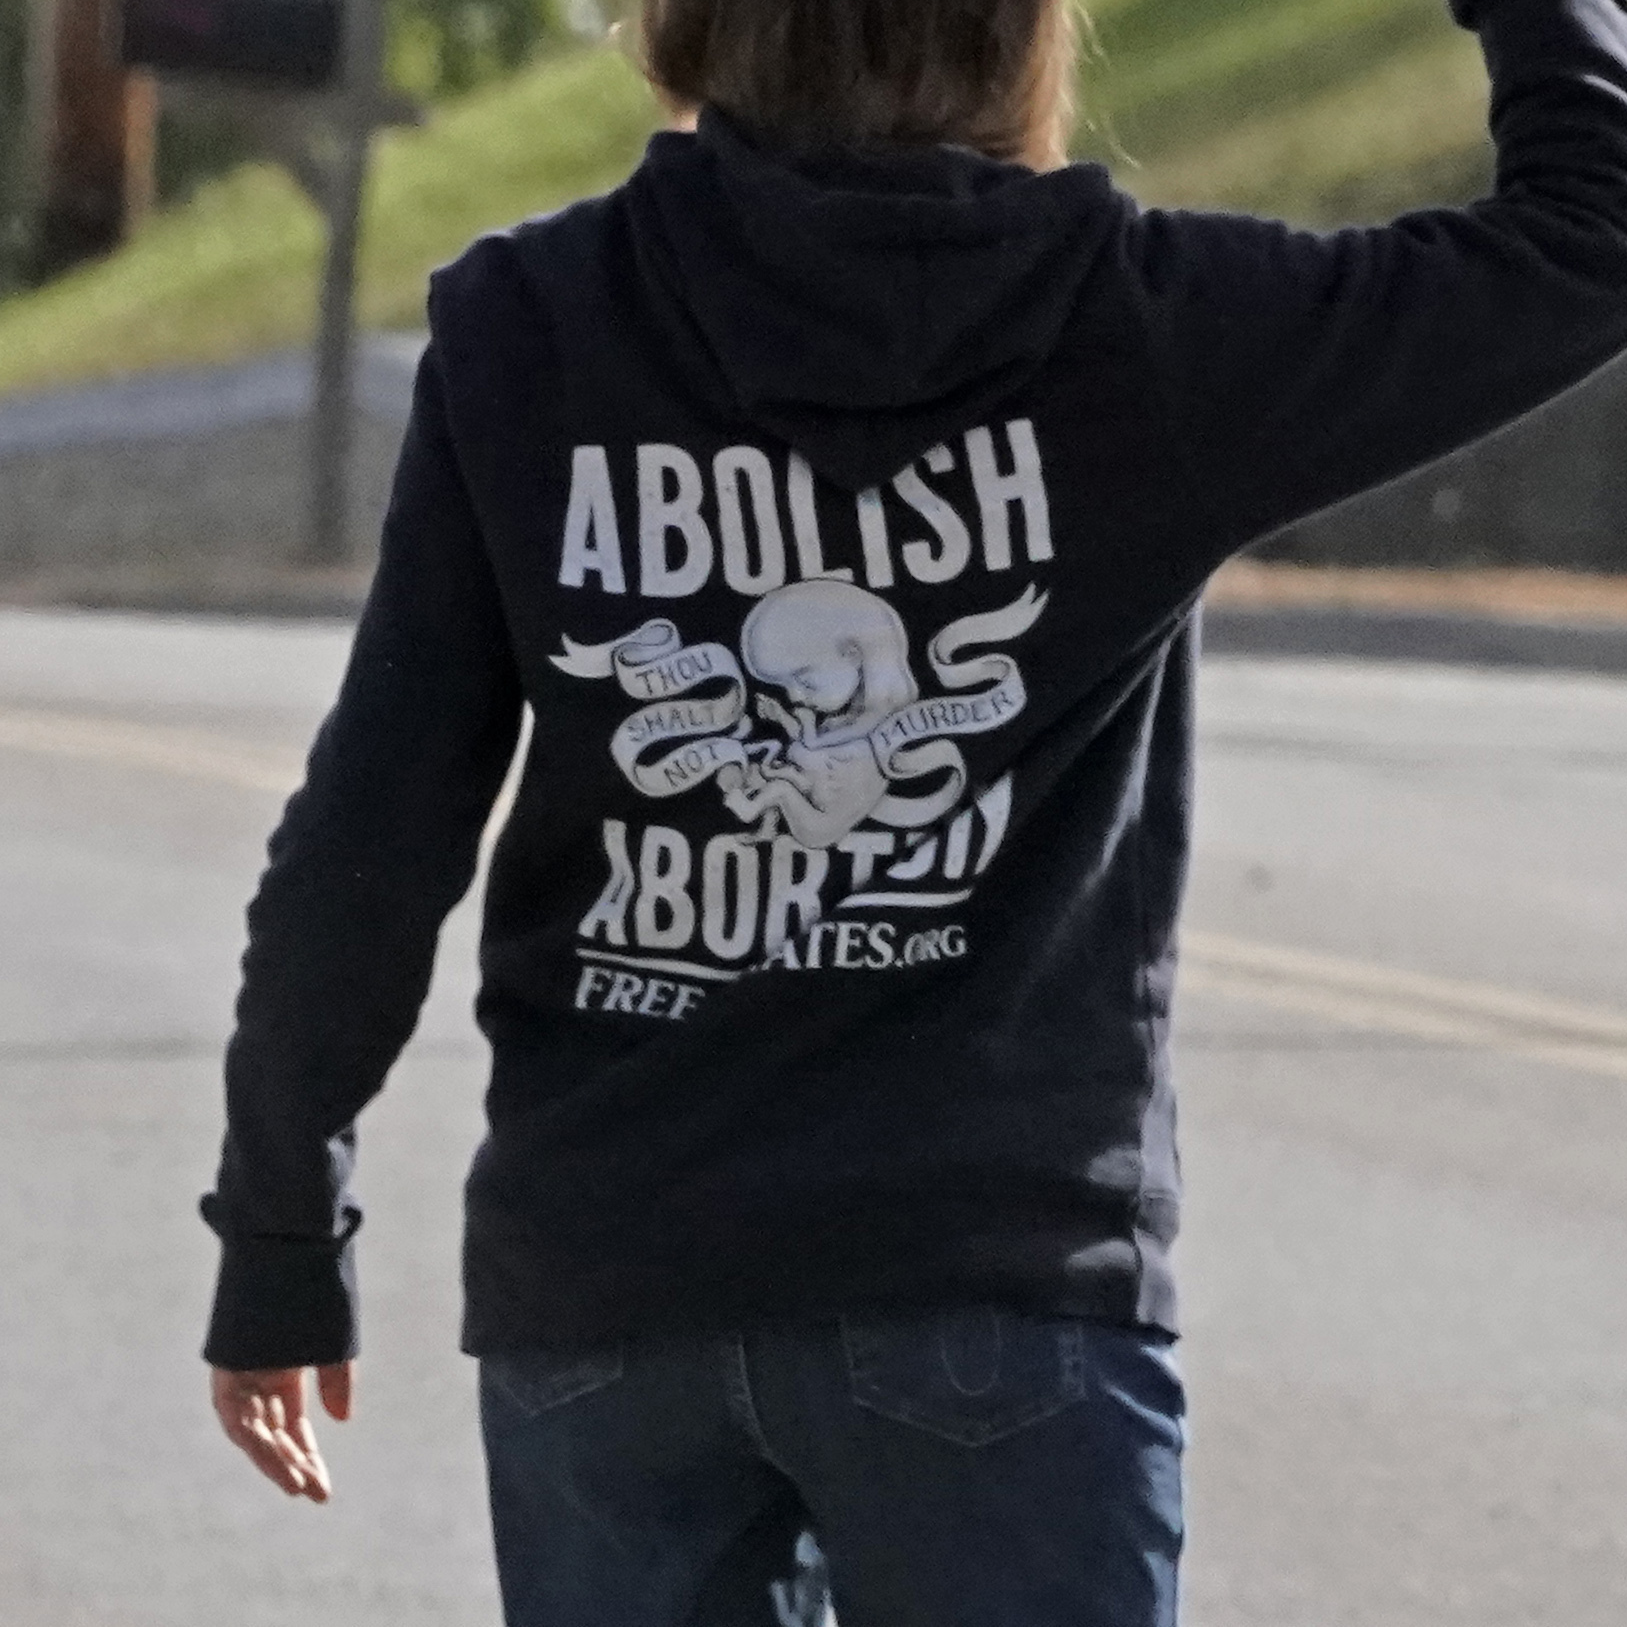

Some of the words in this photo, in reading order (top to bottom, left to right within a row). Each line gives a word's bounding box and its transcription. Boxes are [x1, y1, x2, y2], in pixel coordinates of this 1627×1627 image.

[558, 418, 1055, 598] ABOLISH
[635, 652, 713, 697] THOU
[880, 690, 1014, 748] MURDER
[663, 744, 721, 789] NOT
